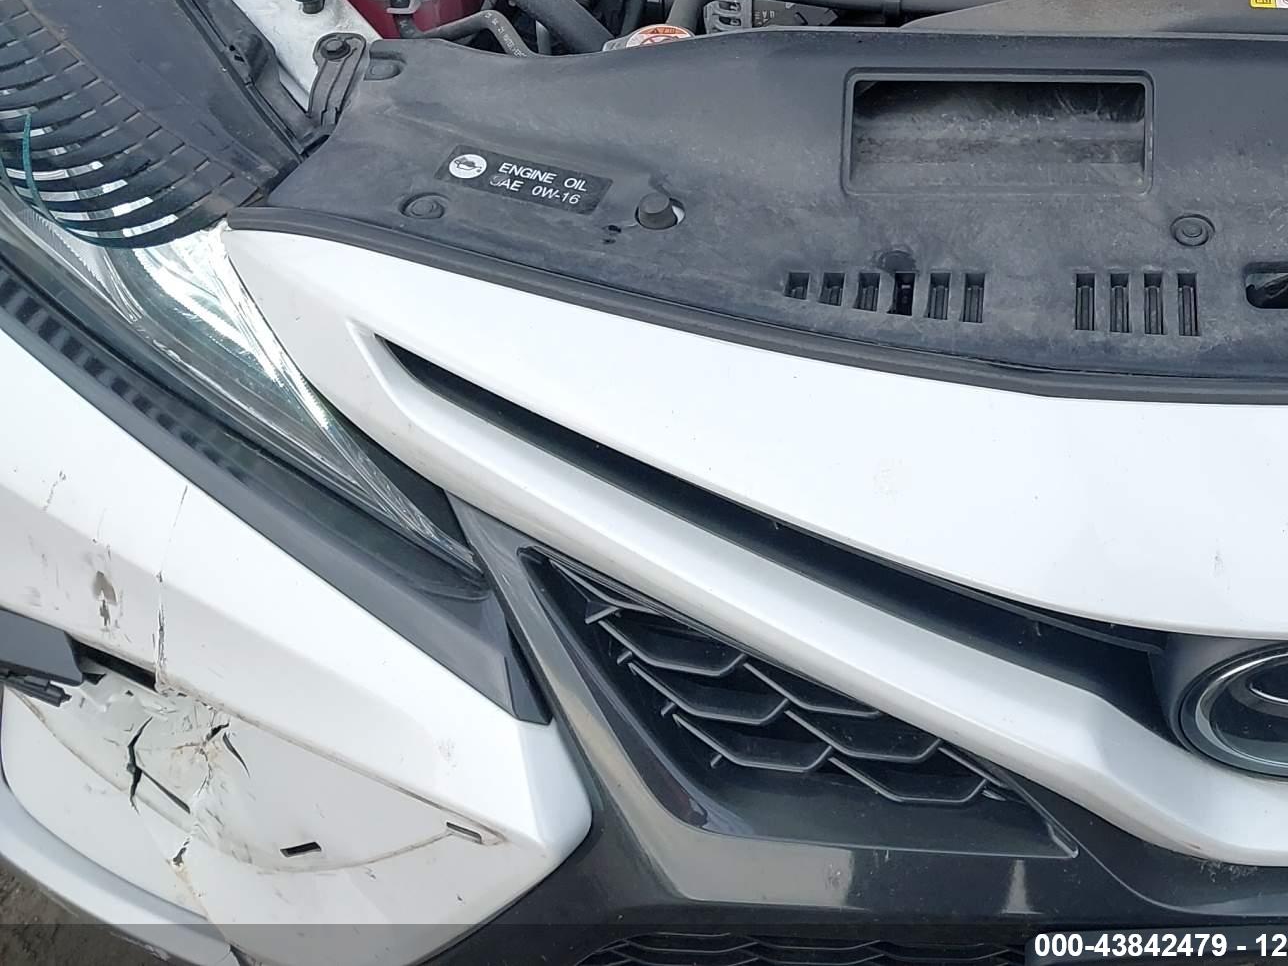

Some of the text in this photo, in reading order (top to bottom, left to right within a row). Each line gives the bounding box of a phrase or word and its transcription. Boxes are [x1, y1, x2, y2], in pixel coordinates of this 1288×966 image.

[489, 174, 524, 192] SAE
[498, 162, 588, 192] ENGINE OIL
